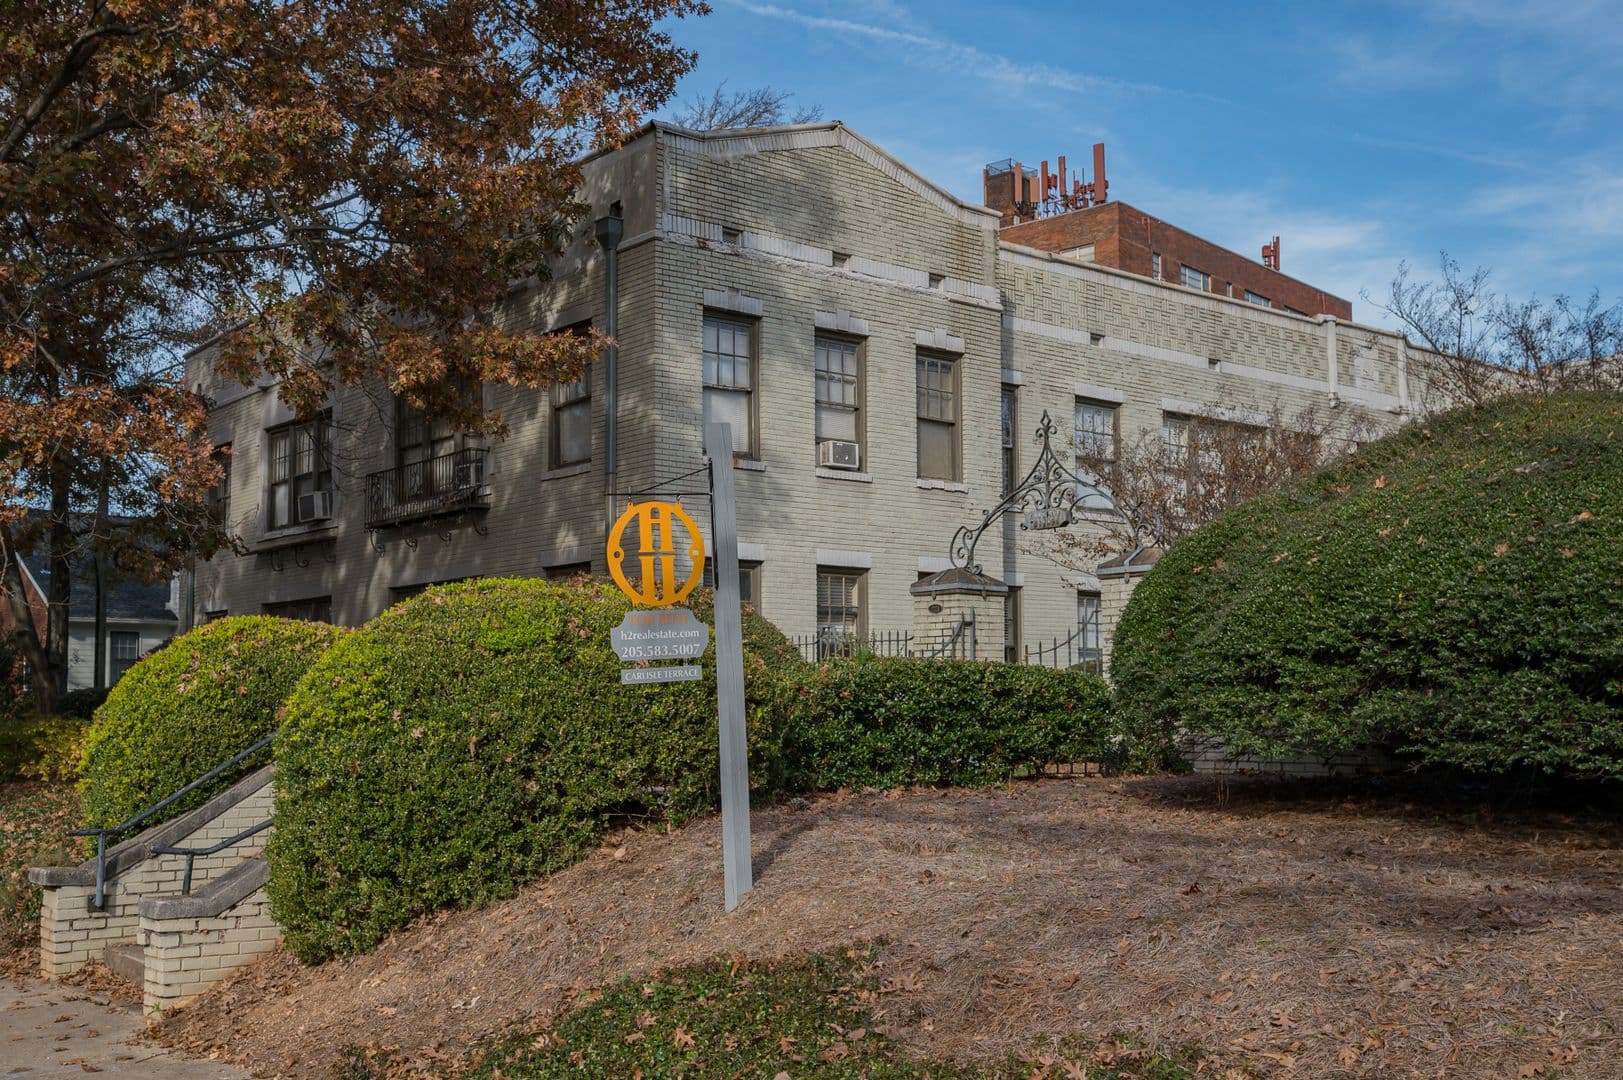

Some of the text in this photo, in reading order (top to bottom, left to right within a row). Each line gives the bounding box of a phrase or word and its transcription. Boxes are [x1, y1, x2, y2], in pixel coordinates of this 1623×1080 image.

[620, 630, 700, 640] h2realestate.com
[621, 643, 701, 658] 205.583.5007
[625, 668, 698, 681] CARLISLE TERRACE
